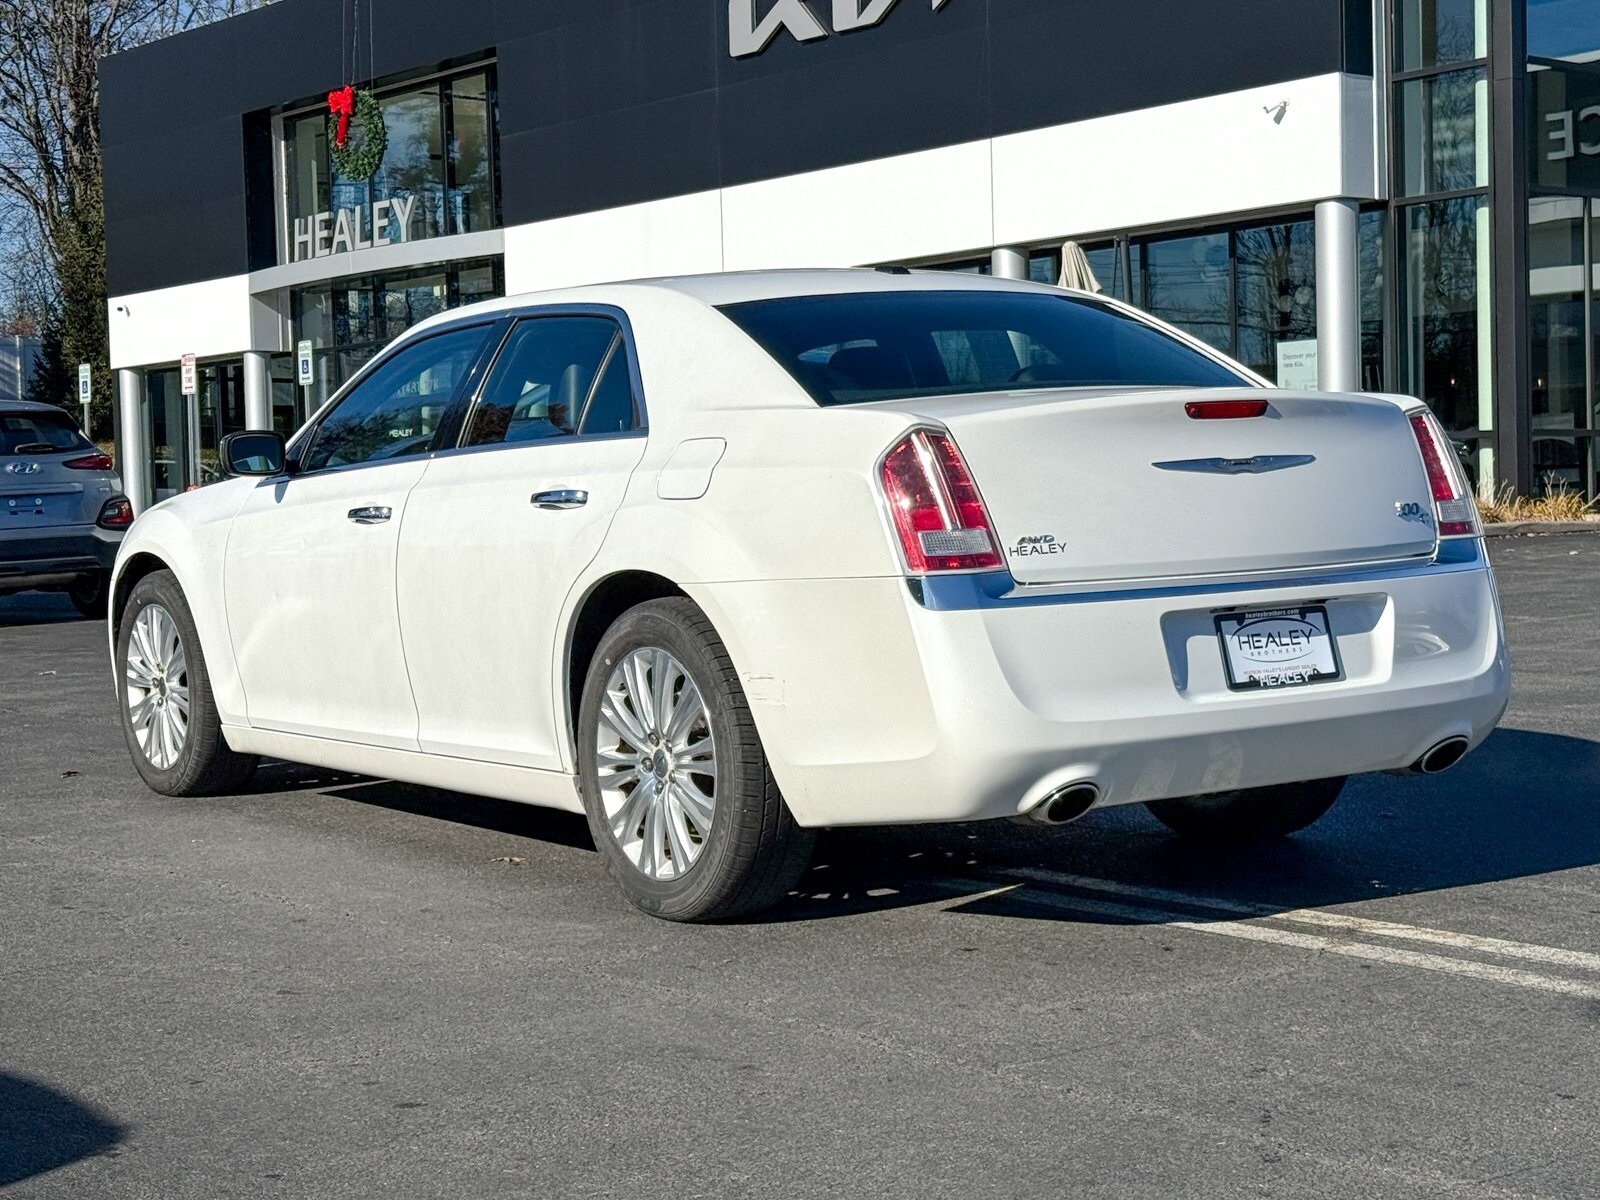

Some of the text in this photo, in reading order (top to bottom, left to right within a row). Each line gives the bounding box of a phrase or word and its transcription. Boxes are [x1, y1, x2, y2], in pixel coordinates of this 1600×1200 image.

[294, 195, 415, 262] HEALEY
[1017, 535, 1055, 545] AWD
[1009, 543, 1067, 557] HEALEY
[1245, 609, 1300, 619] healeybrothers.com
[1237, 629, 1313, 651] HEALEY
[1250, 647, 1303, 657] BROTHERS
[1260, 671, 1309, 687] HEALEY
